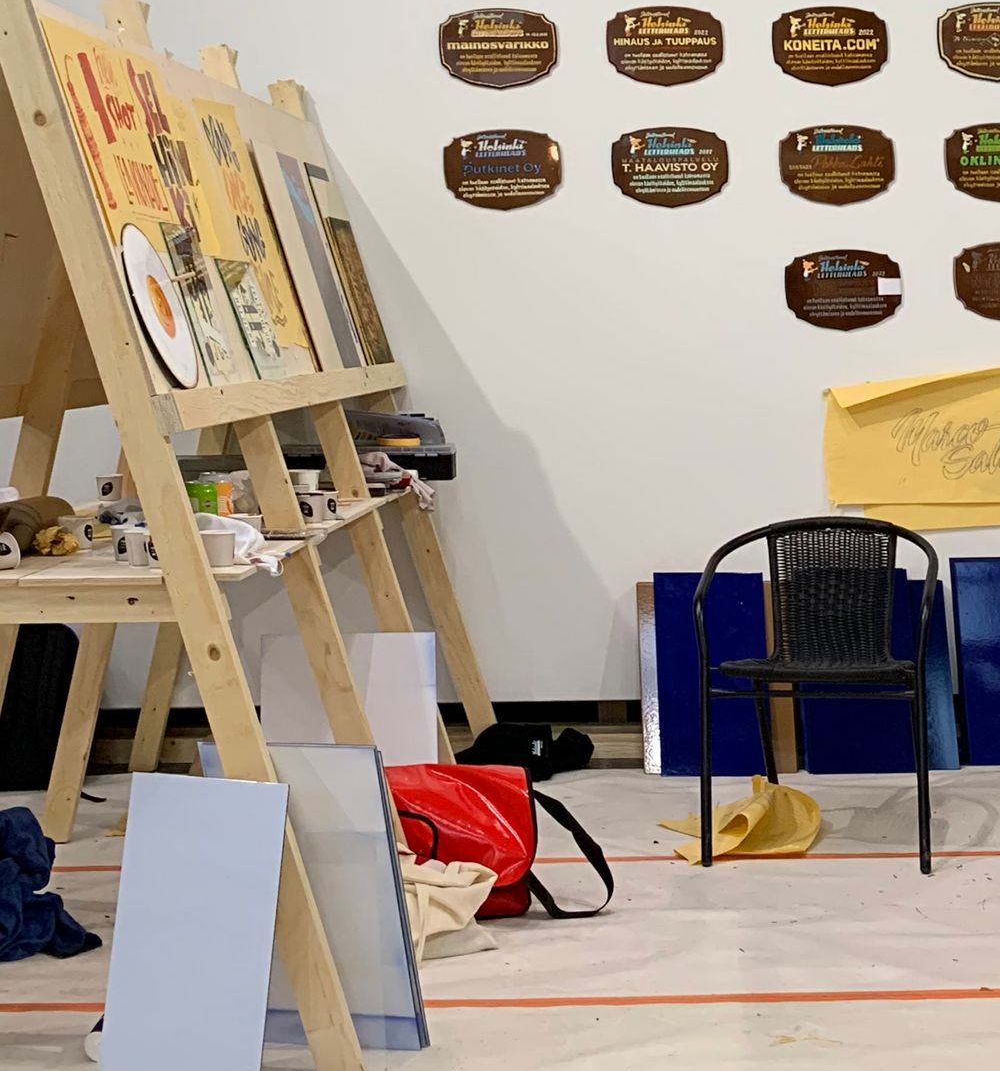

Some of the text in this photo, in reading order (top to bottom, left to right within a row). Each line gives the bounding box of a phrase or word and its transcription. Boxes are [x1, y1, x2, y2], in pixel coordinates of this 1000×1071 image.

[641, 16, 688, 28] Helsinki
[807, 17, 852, 29] Helsinki
[614, 37, 650, 46] HINAUS
[665, 37, 717, 46] TUUPPAUS
[478, 138, 524, 151] Helsinki
[523, 162, 541, 174] Oy
[622, 162, 719, 172] T. HAAVISTO OY
[820, 260, 865, 272] Helsinki
